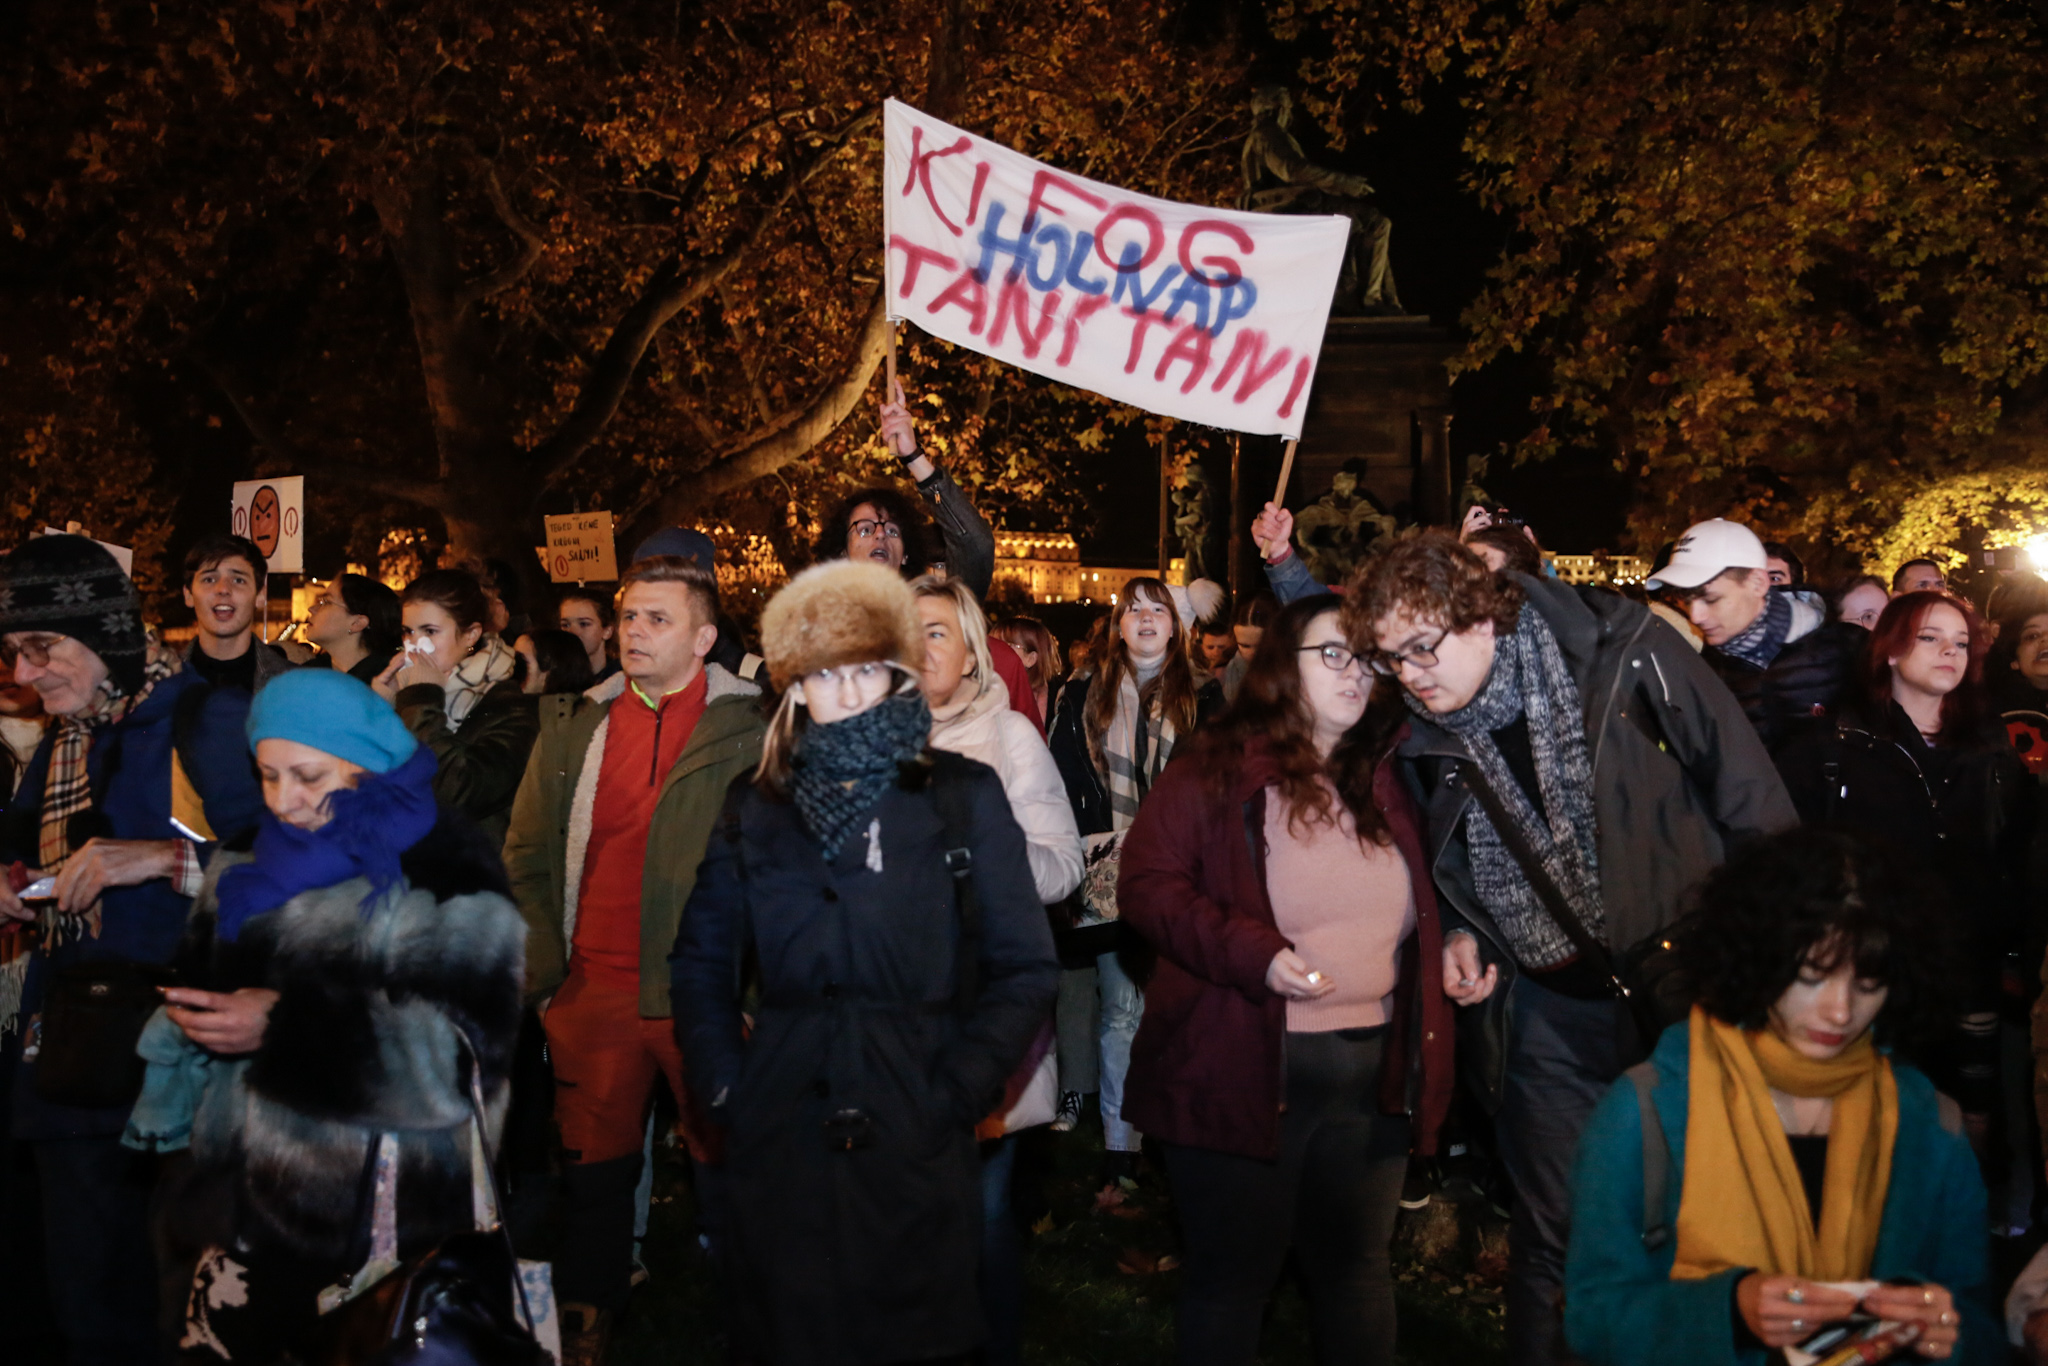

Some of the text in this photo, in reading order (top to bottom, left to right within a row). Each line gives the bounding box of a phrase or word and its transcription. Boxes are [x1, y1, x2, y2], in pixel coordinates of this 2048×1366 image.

[902, 126, 1255, 287] KI FOG
[977, 200, 1257, 338] HOLNAP
